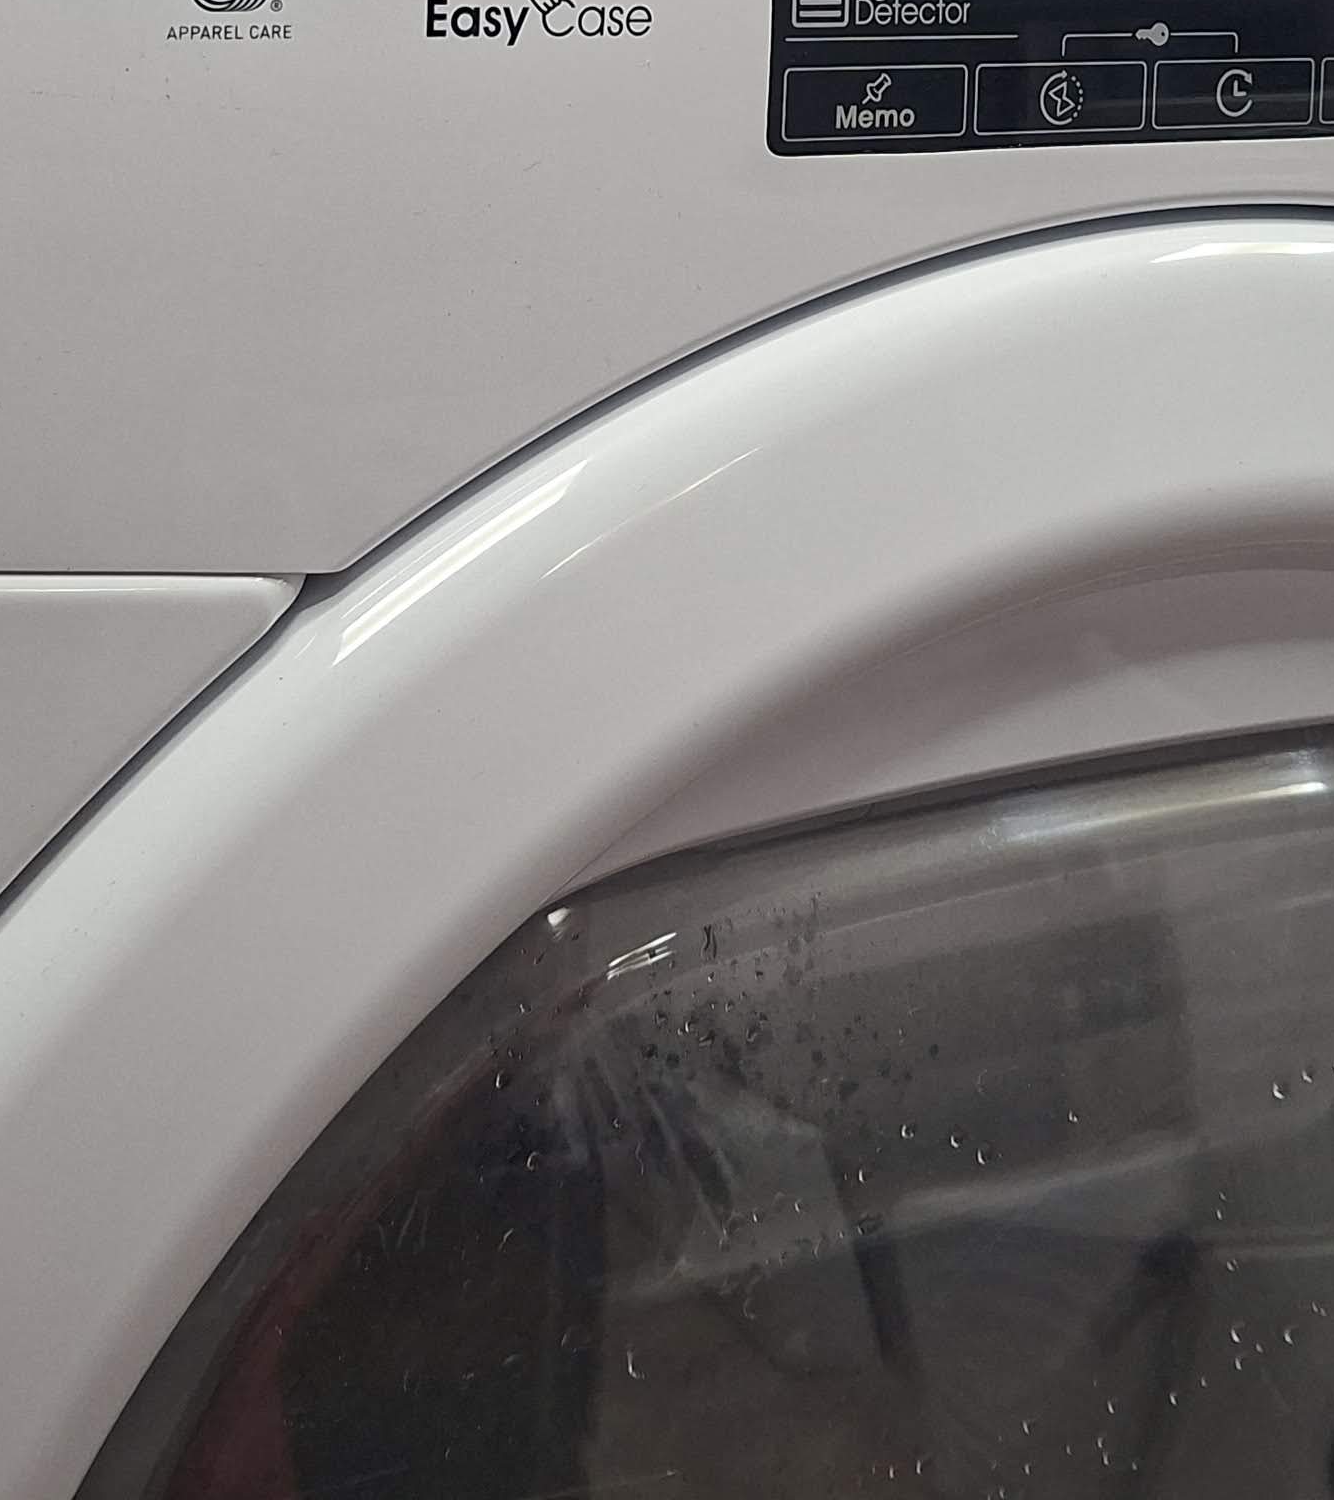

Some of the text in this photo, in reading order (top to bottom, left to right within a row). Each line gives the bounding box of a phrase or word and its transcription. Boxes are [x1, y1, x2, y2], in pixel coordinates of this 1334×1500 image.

[167, 25, 293, 40] APPAREL CARE
[835, 104, 916, 129] Memo
